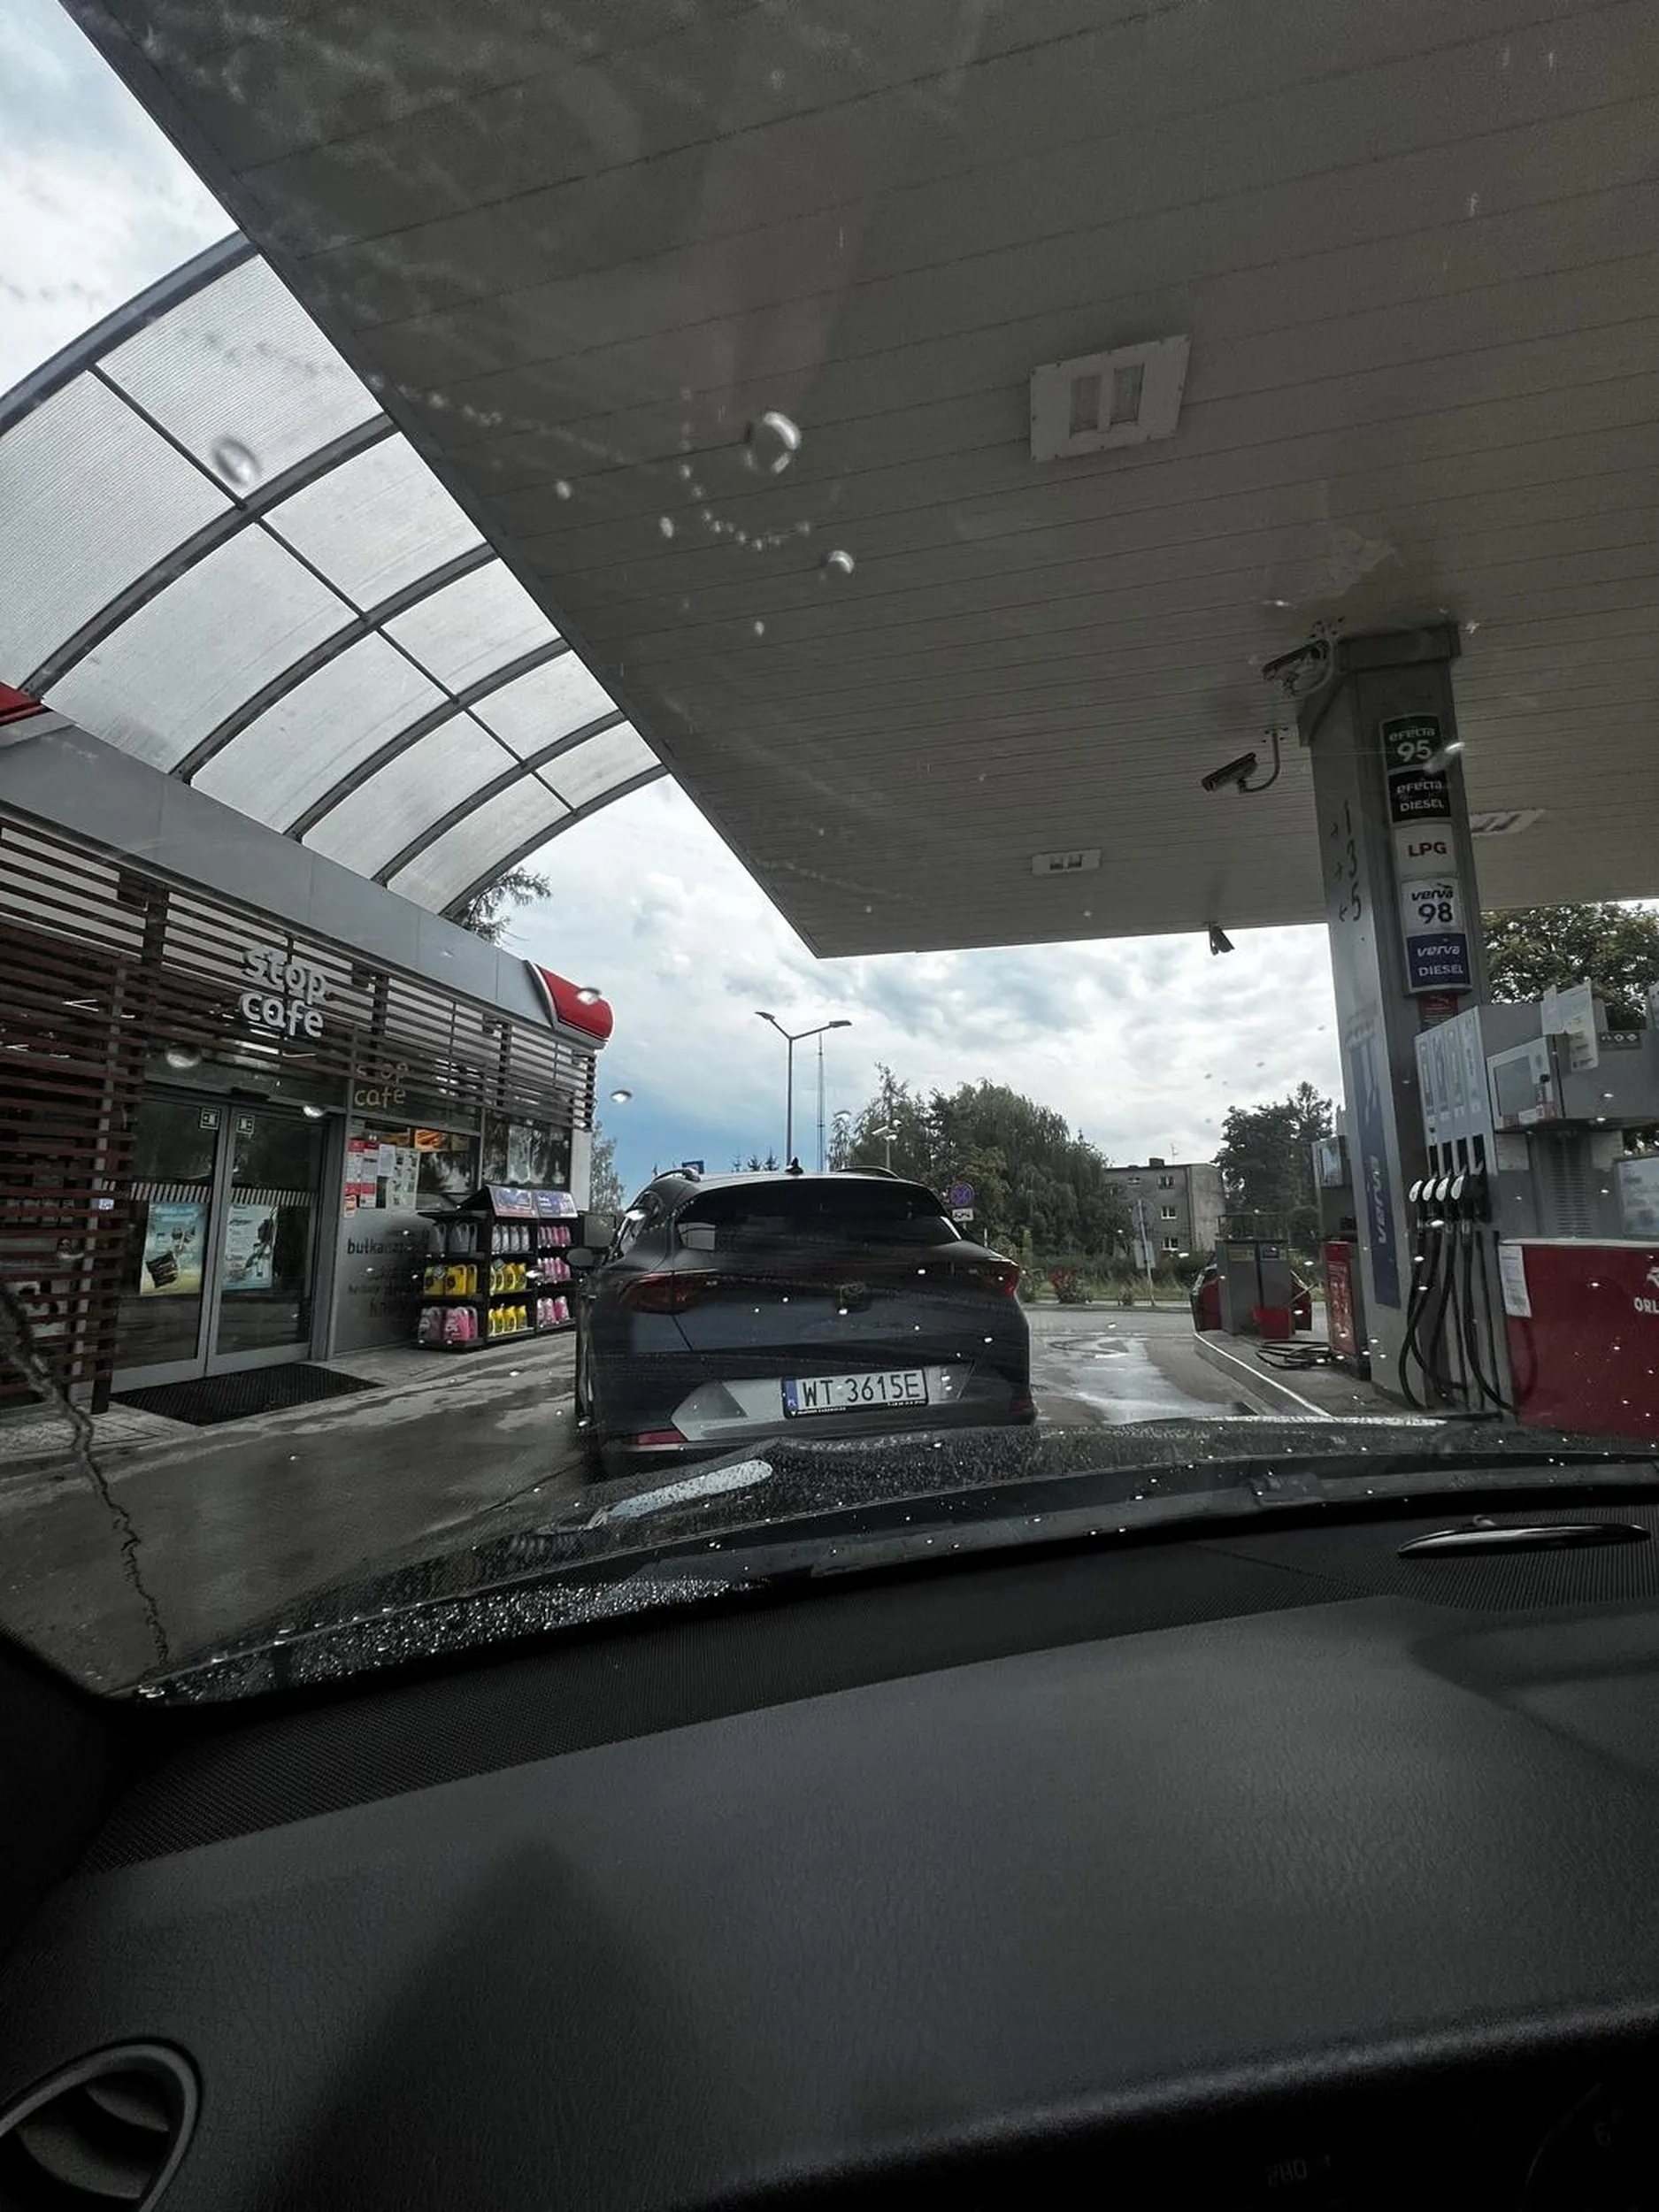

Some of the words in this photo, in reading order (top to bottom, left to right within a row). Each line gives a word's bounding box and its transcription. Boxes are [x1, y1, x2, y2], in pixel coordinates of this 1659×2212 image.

[1397, 740, 1432, 762] 95
[1400, 798, 1444, 812] DIESEL
[1409, 841, 1448, 857] LPG
[1411, 886, 1454, 902] verva
[1417, 902, 1454, 925] 98
[1417, 944, 1460, 956] verva
[244, 949, 326, 1005] stop
[1417, 964, 1463, 977] DIESEL
[242, 993, 324, 1038] cafe
[356, 1062, 409, 1086] sop
[354, 1087, 406, 1110] cafe
[803, 1380, 833, 1407] WT
[845, 1373, 920, 1403] 3615E
